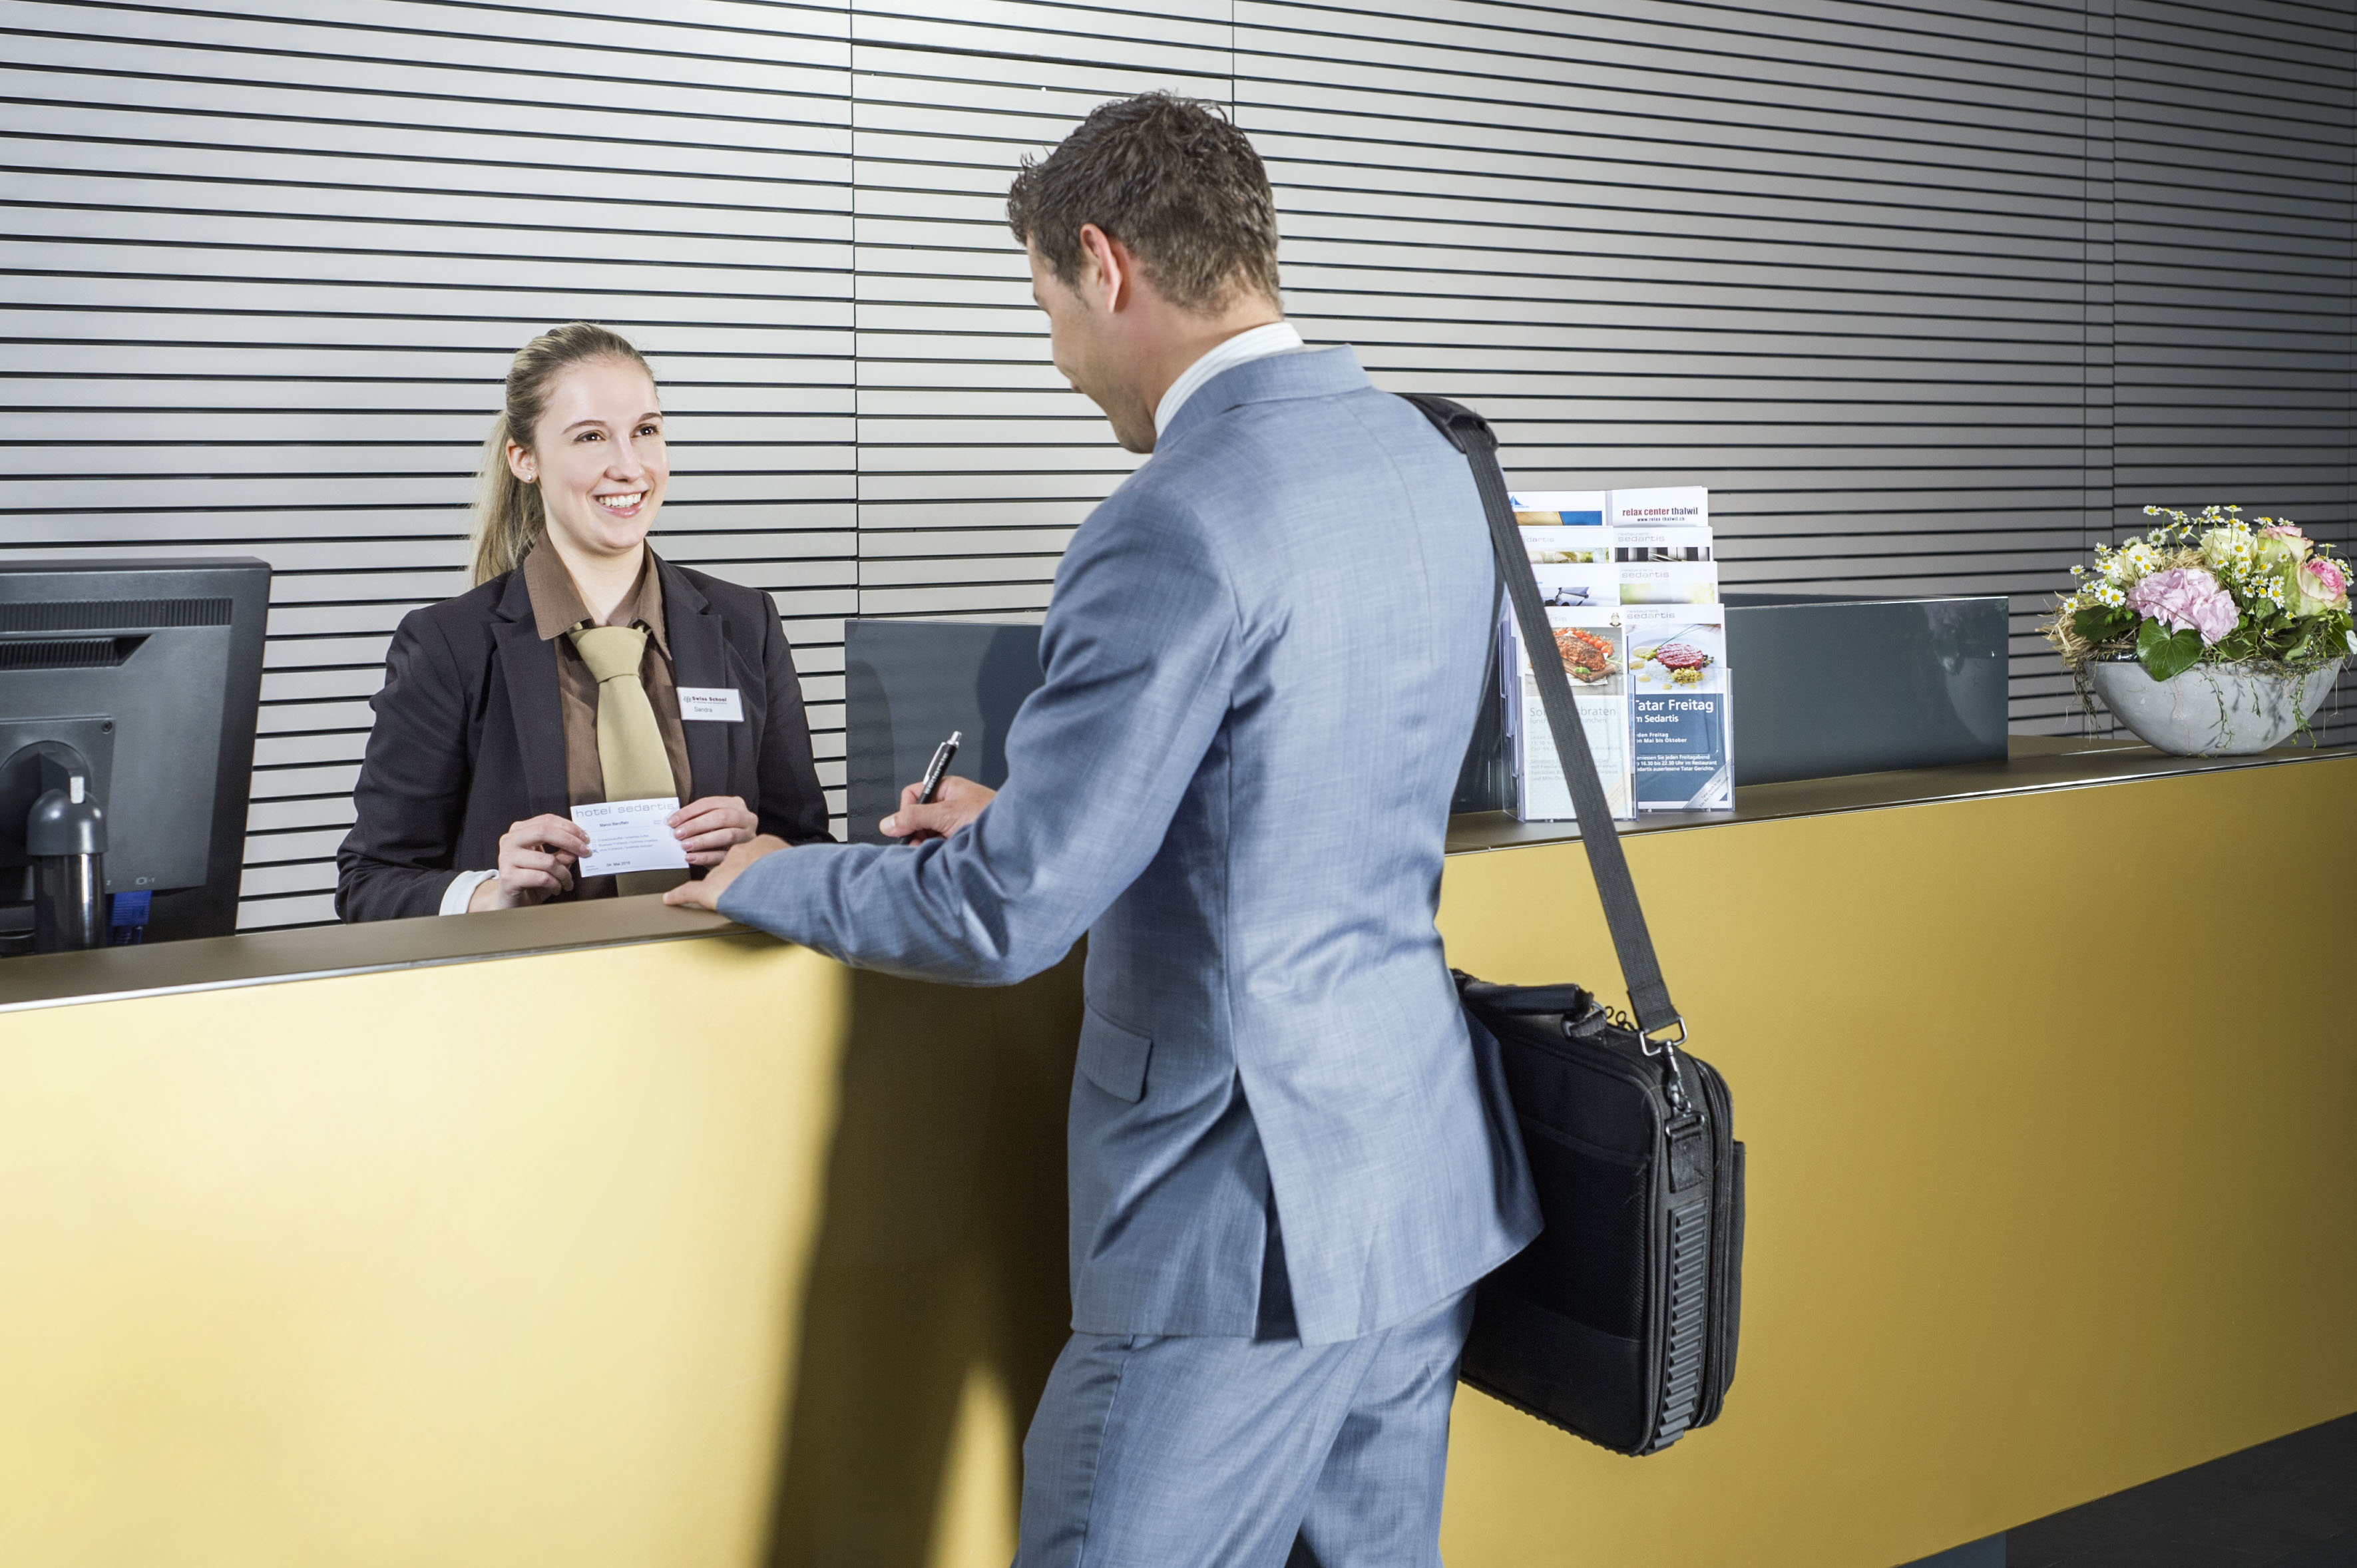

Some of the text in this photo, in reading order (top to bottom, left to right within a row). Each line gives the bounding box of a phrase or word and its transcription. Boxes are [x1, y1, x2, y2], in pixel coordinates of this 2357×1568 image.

[1622, 508, 1643, 516] relax
[1668, 698, 1714, 713] Freitag
[1644, 714, 1679, 723] Sedartis
[576, 802, 675, 817] hotel sedartis
